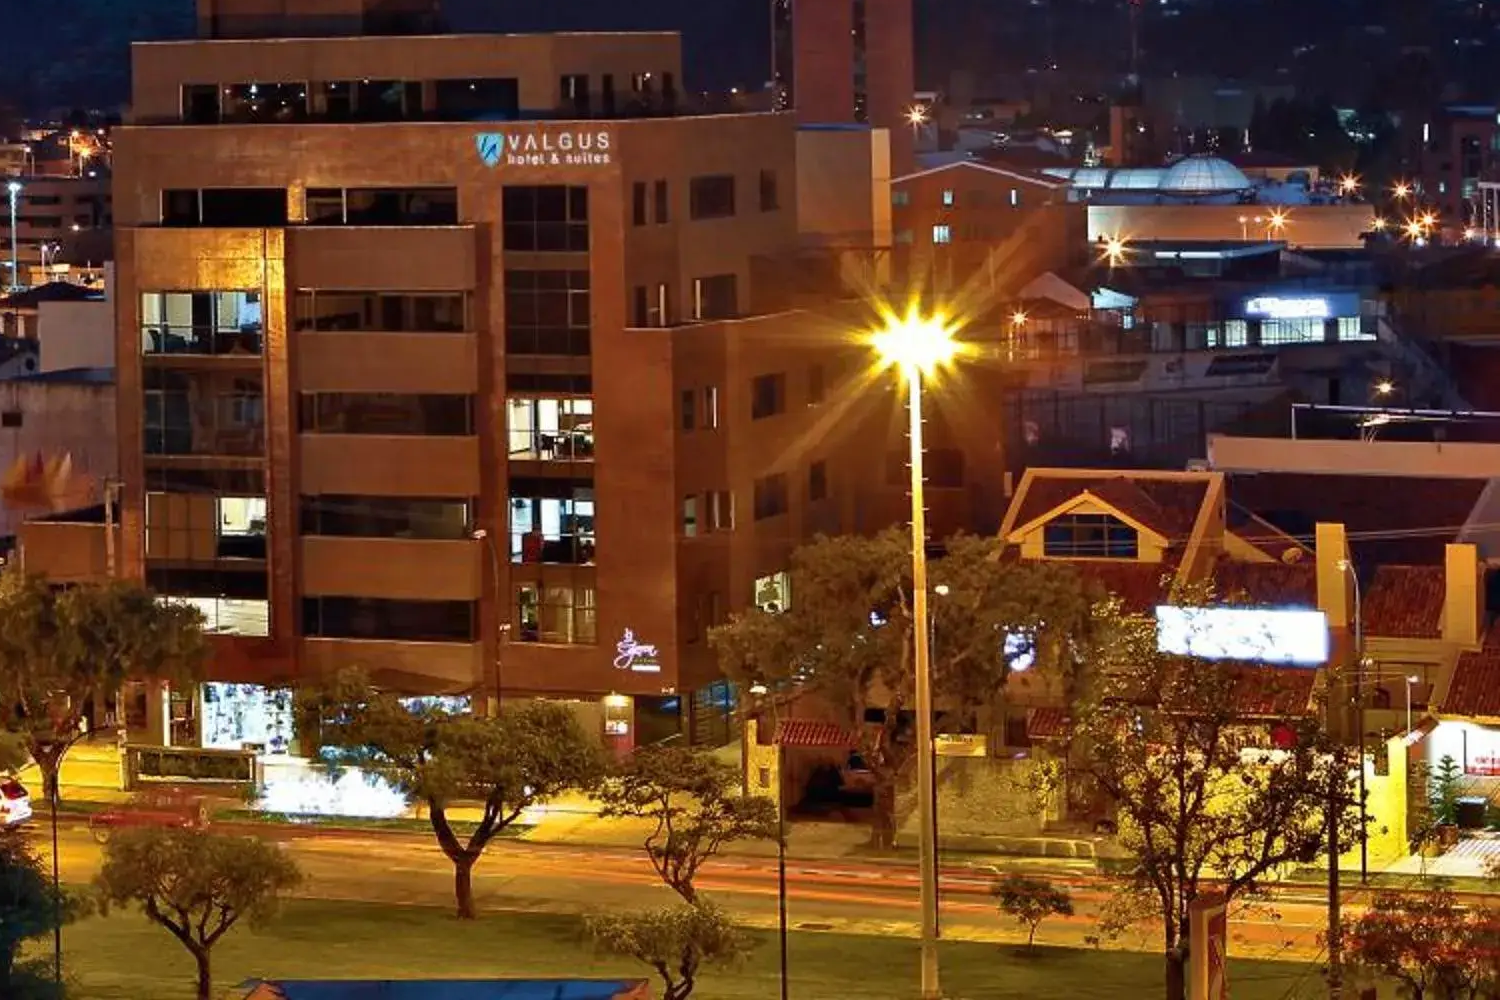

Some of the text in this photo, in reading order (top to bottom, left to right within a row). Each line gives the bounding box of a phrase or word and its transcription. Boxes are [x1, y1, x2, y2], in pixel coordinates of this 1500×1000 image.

[507, 131, 610, 150] VALGUS
[507, 152, 611, 165] hotel & suites
